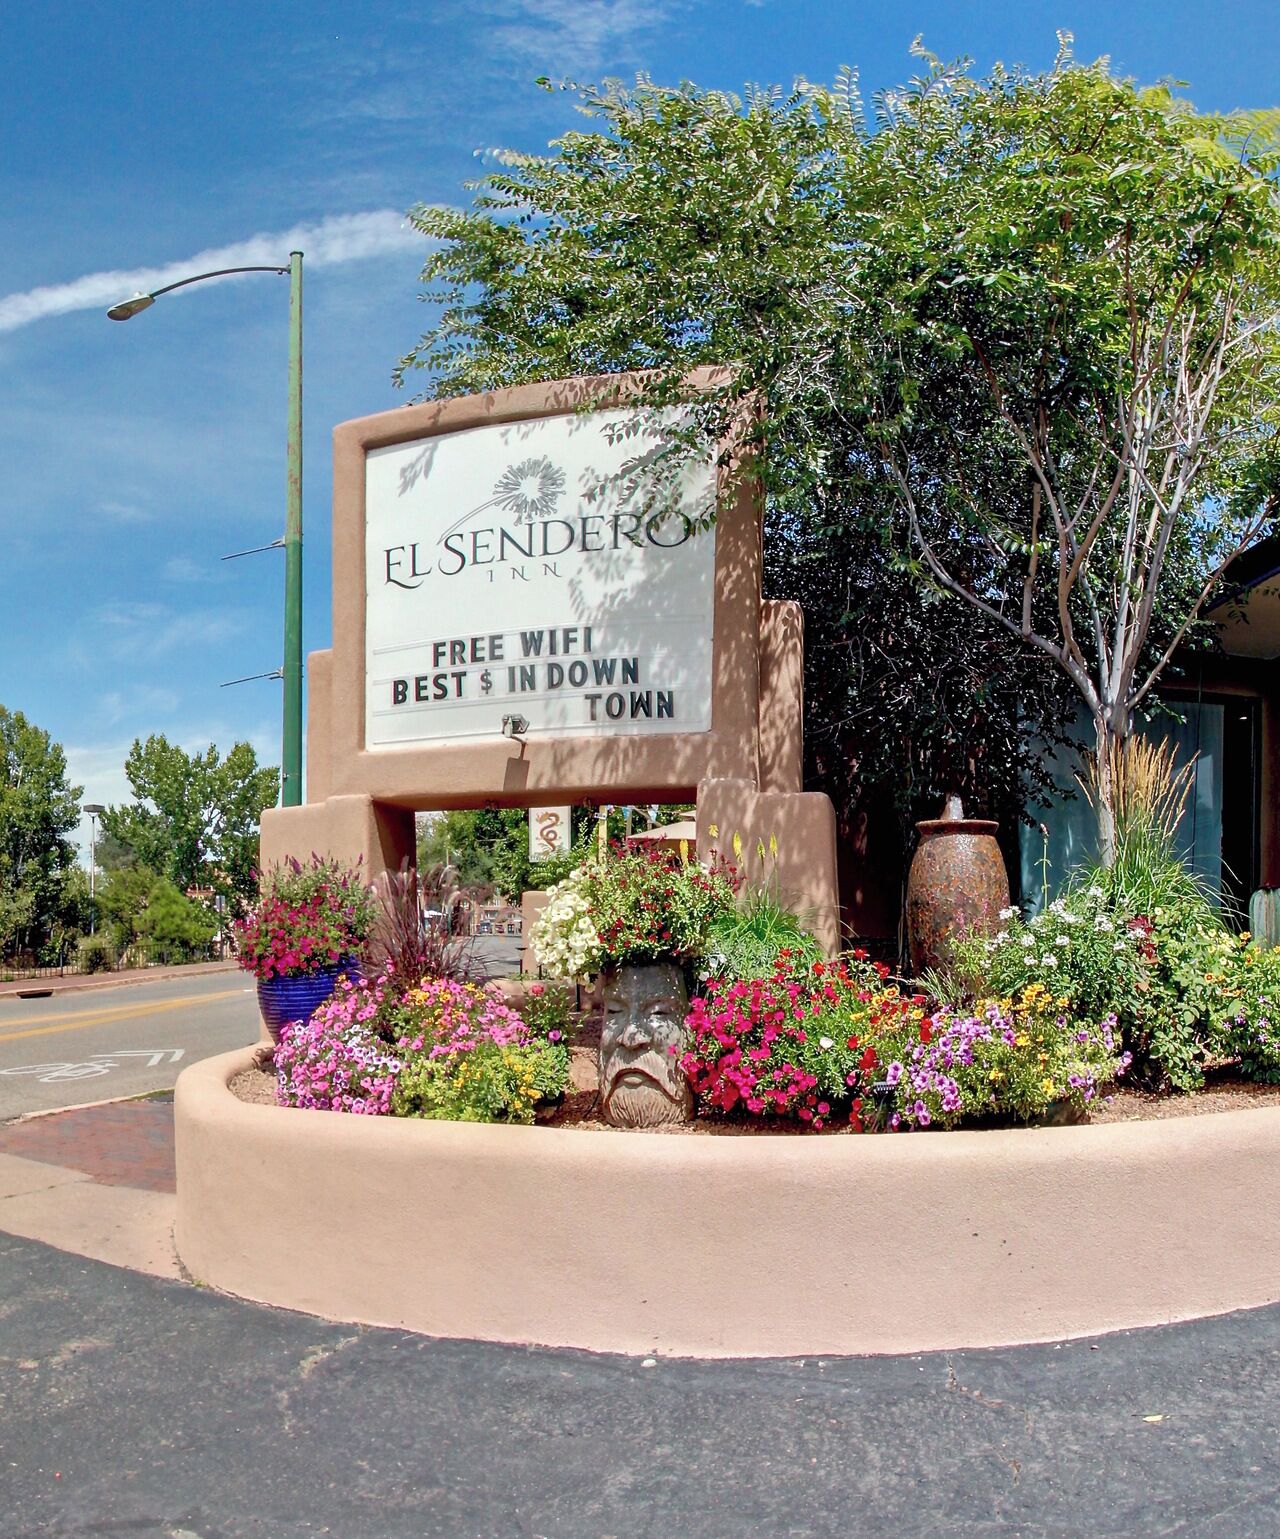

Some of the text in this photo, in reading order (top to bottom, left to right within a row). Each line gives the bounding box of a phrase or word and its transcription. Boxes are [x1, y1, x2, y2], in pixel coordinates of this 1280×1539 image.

[384, 509, 692, 590] EL SENDERO
[487, 560, 563, 583] INN
[432, 626, 593, 668] FREE WIFI
[392, 657, 640, 705] BEST $ IN DOWN
[585, 690, 675, 722] TOWN
